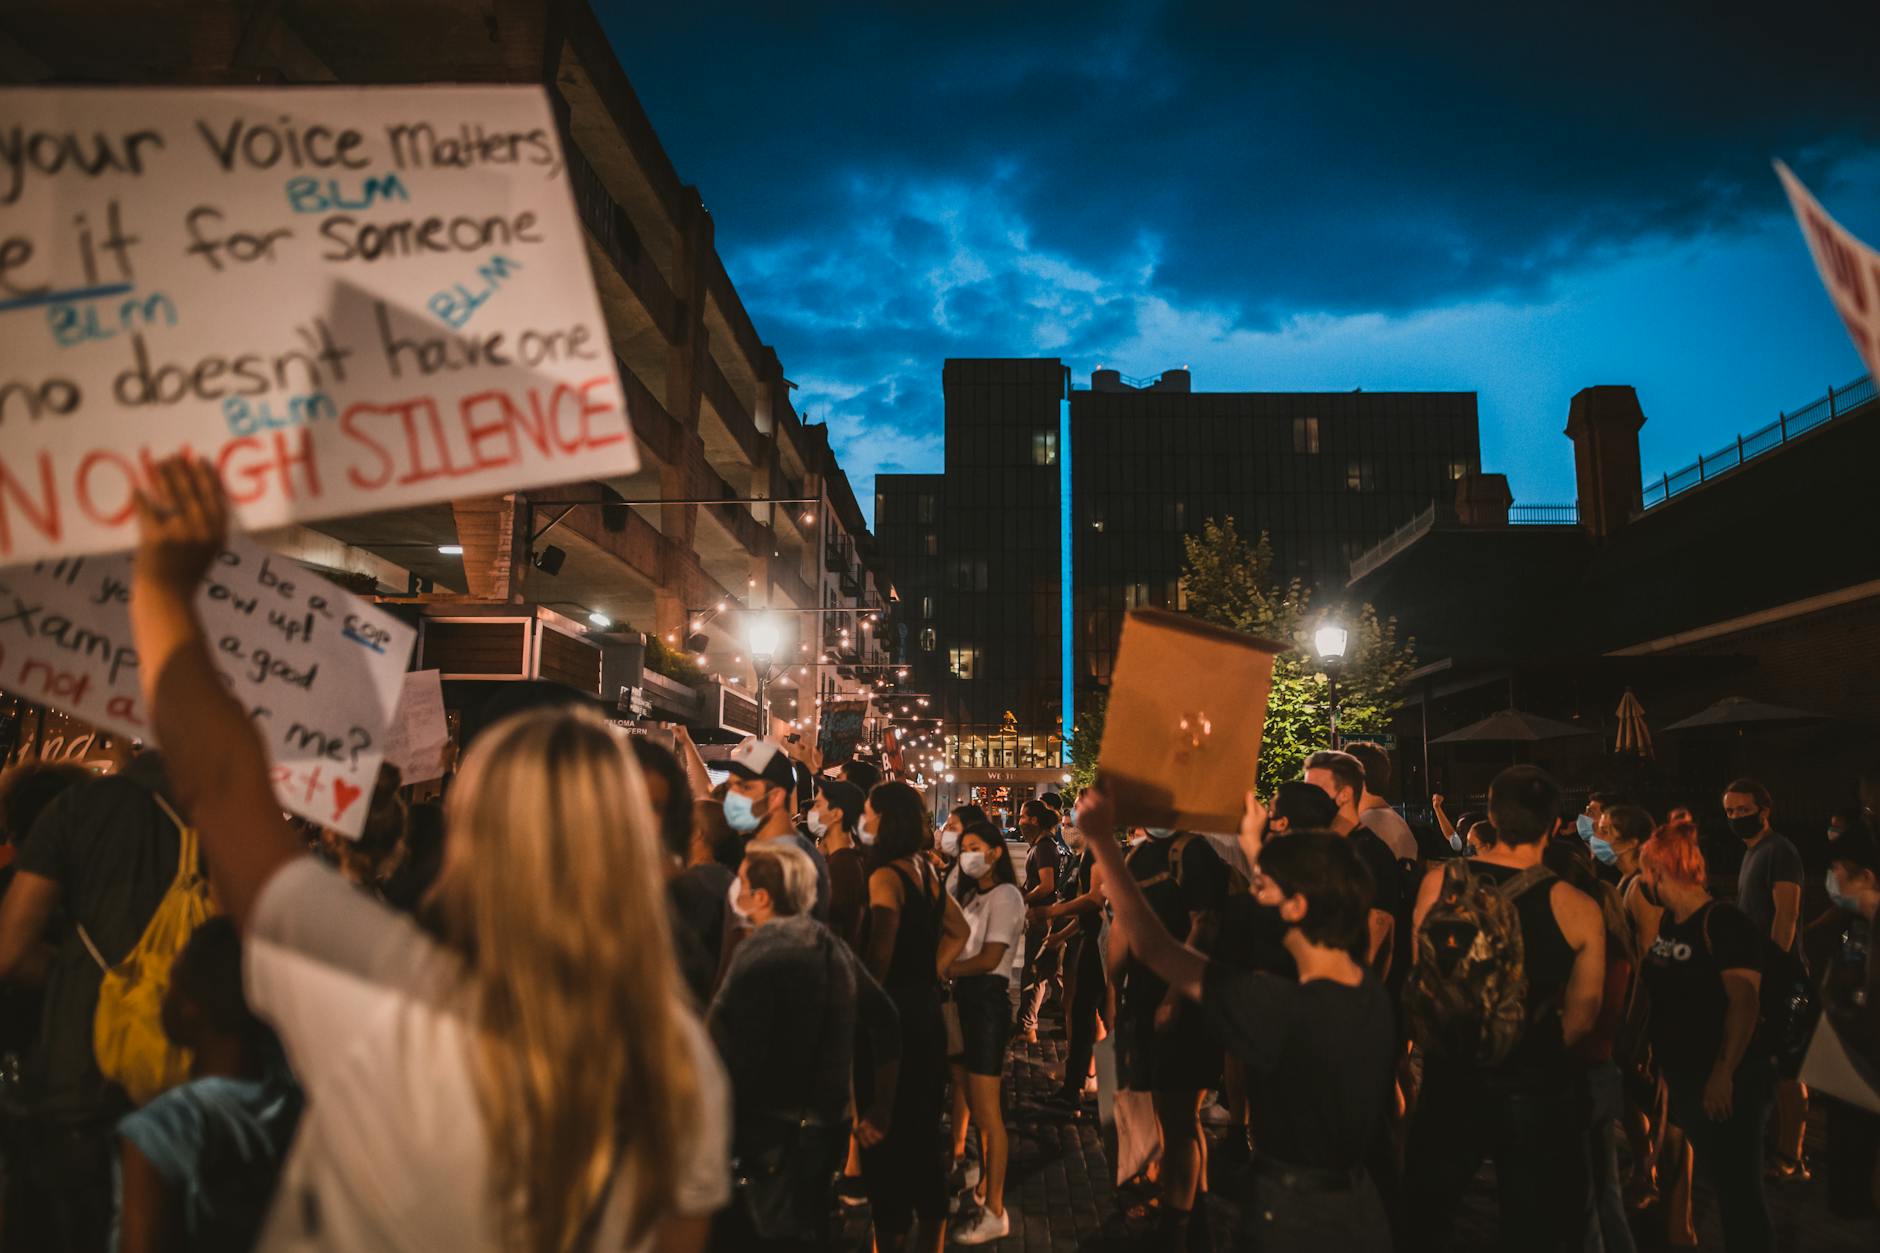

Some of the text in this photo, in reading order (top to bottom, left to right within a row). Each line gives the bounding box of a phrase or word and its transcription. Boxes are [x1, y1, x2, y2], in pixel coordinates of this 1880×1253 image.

[196, 114, 371, 172] Voice
[285, 172, 410, 214] BLM
[72, 200, 140, 286] it
[184, 204, 293, 273] for
[427, 254, 524, 329] BLM
[112, 316, 352, 408] doesn't
[371, 298, 505, 379] have
[517, 322, 598, 368] one
[340, 375, 629, 490] SILENCE
[257, 557, 296, 599] be
[307, 594, 335, 620] a
[246, 648, 319, 691] good
[283, 721, 373, 773] me?
